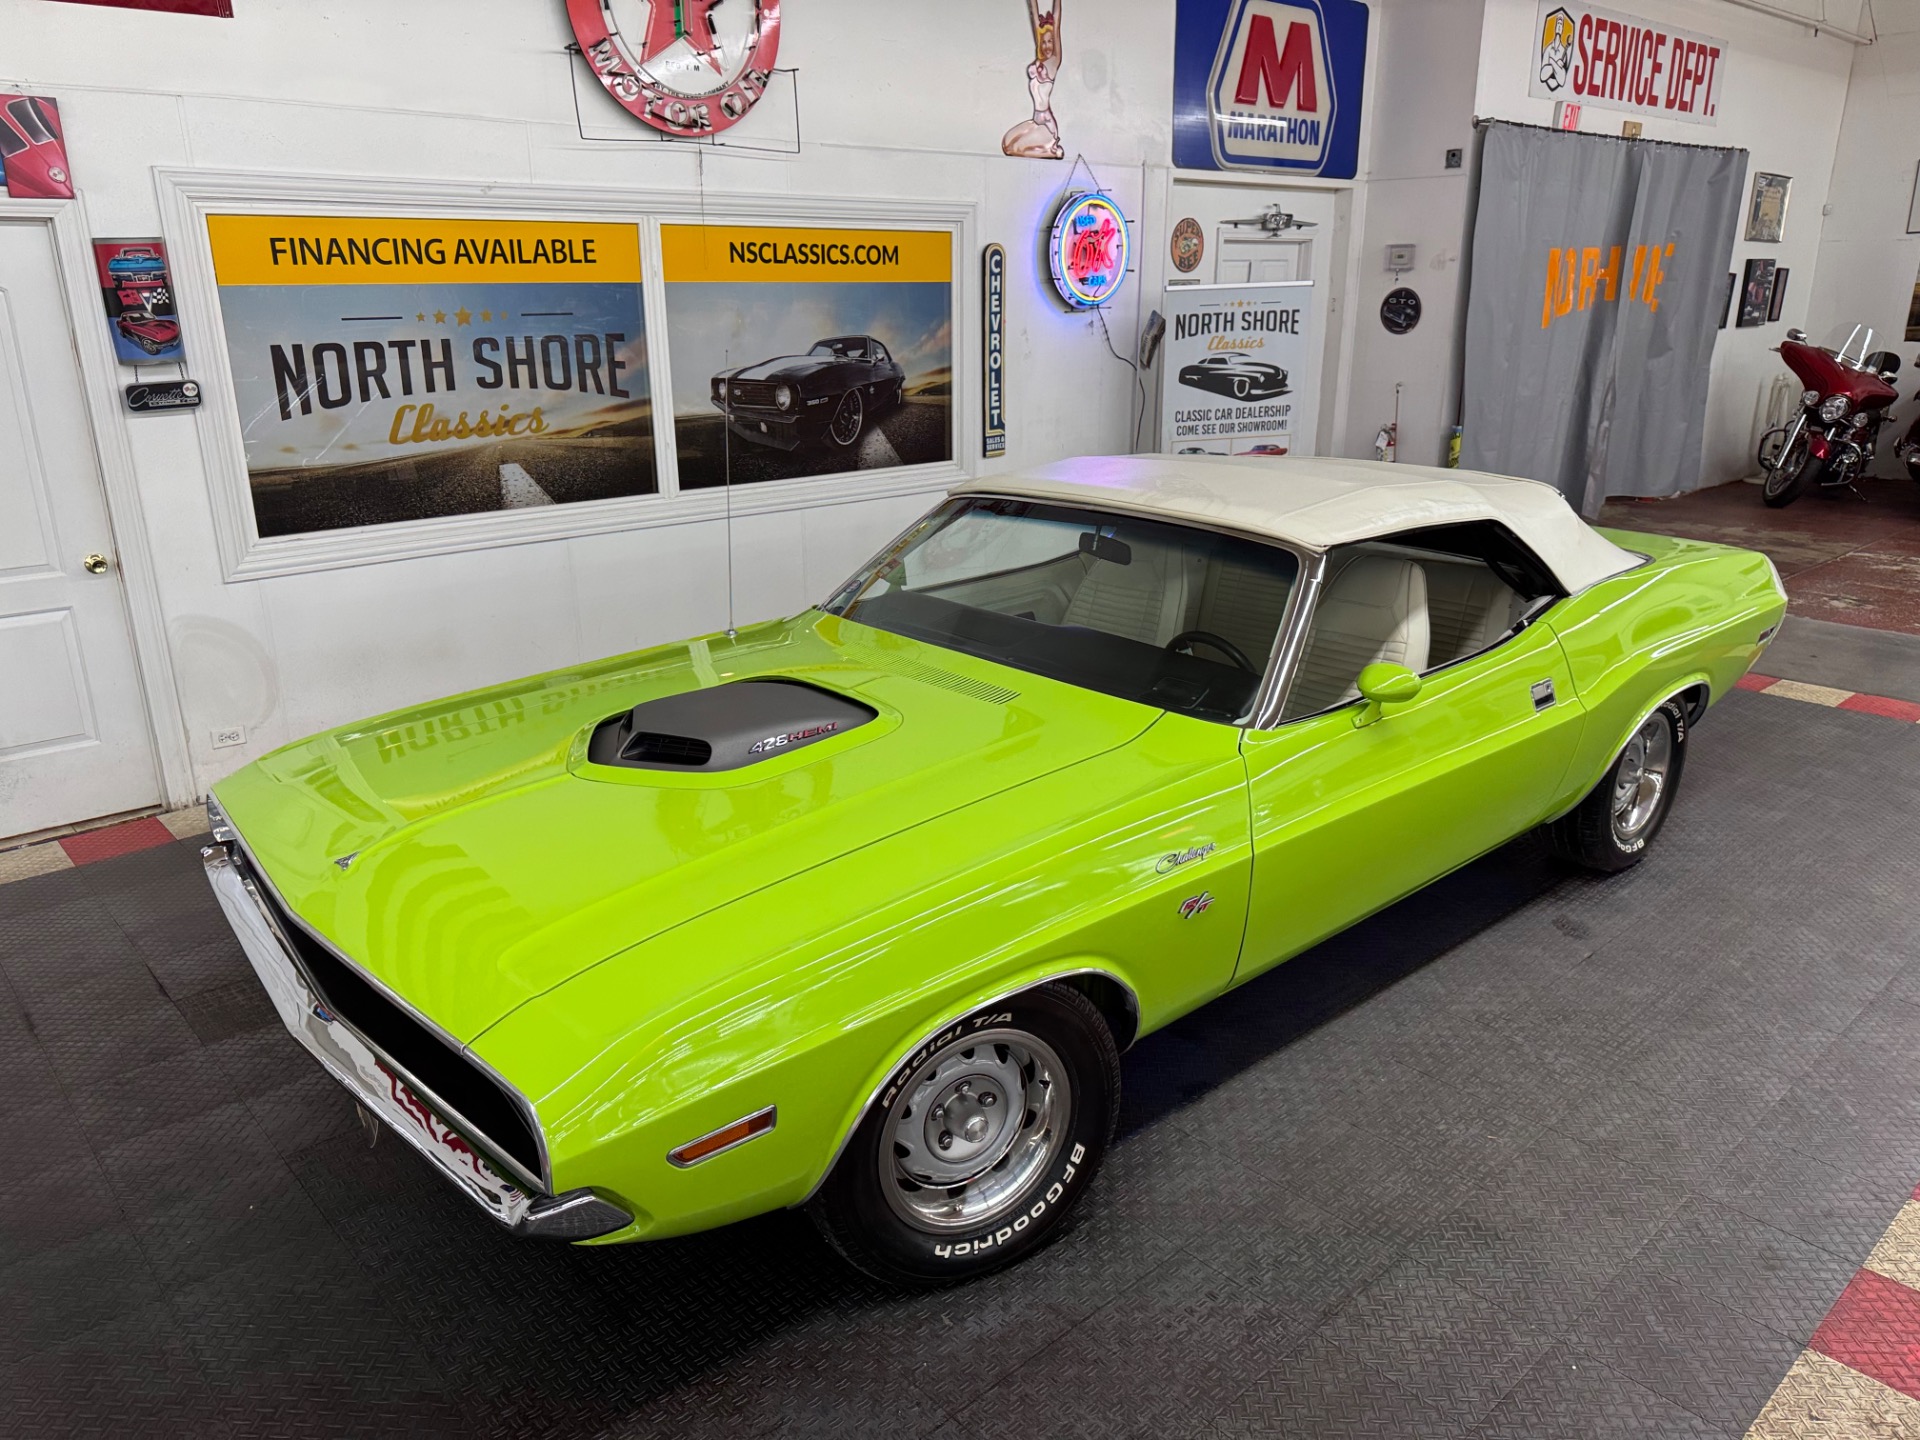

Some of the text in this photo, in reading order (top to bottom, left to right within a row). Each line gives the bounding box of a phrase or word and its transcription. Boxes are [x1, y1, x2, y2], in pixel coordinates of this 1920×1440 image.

[1573, 14, 1720, 116] SERVICE DEPT.
[589, 37, 713, 133] MOTOR
[1227, 111, 1320, 146] MARATHON
[1562, 103, 1581, 131] EXIT
[269, 236, 597, 266] FINANCING AVAILABLE
[729, 241, 899, 266] NSCLASSICS.COM
[1178, 251, 1199, 269] BEE
[1388, 297, 1416, 305] GTO
[989, 254, 1002, 426] CHEVROLET
[1175, 311, 1235, 341] NORTH
[1241, 309, 1300, 335] SHORE
[1207, 335, 1265, 351] Classics
[269, 333, 630, 421] NORTH SHORE
[129, 387, 186, 407] Corvette
[388, 403, 550, 445] Classics
[1175, 404, 1291, 423] CLASSIC CAR DEALERSHIP
[1176, 420, 1287, 436] COME SEE OUR SHOWROOM!
[1177, 890, 1215, 919] R/T
[882, 1011, 1013, 1109] Radial T/A
[934, 1142, 1085, 1259] BFGoodrich
